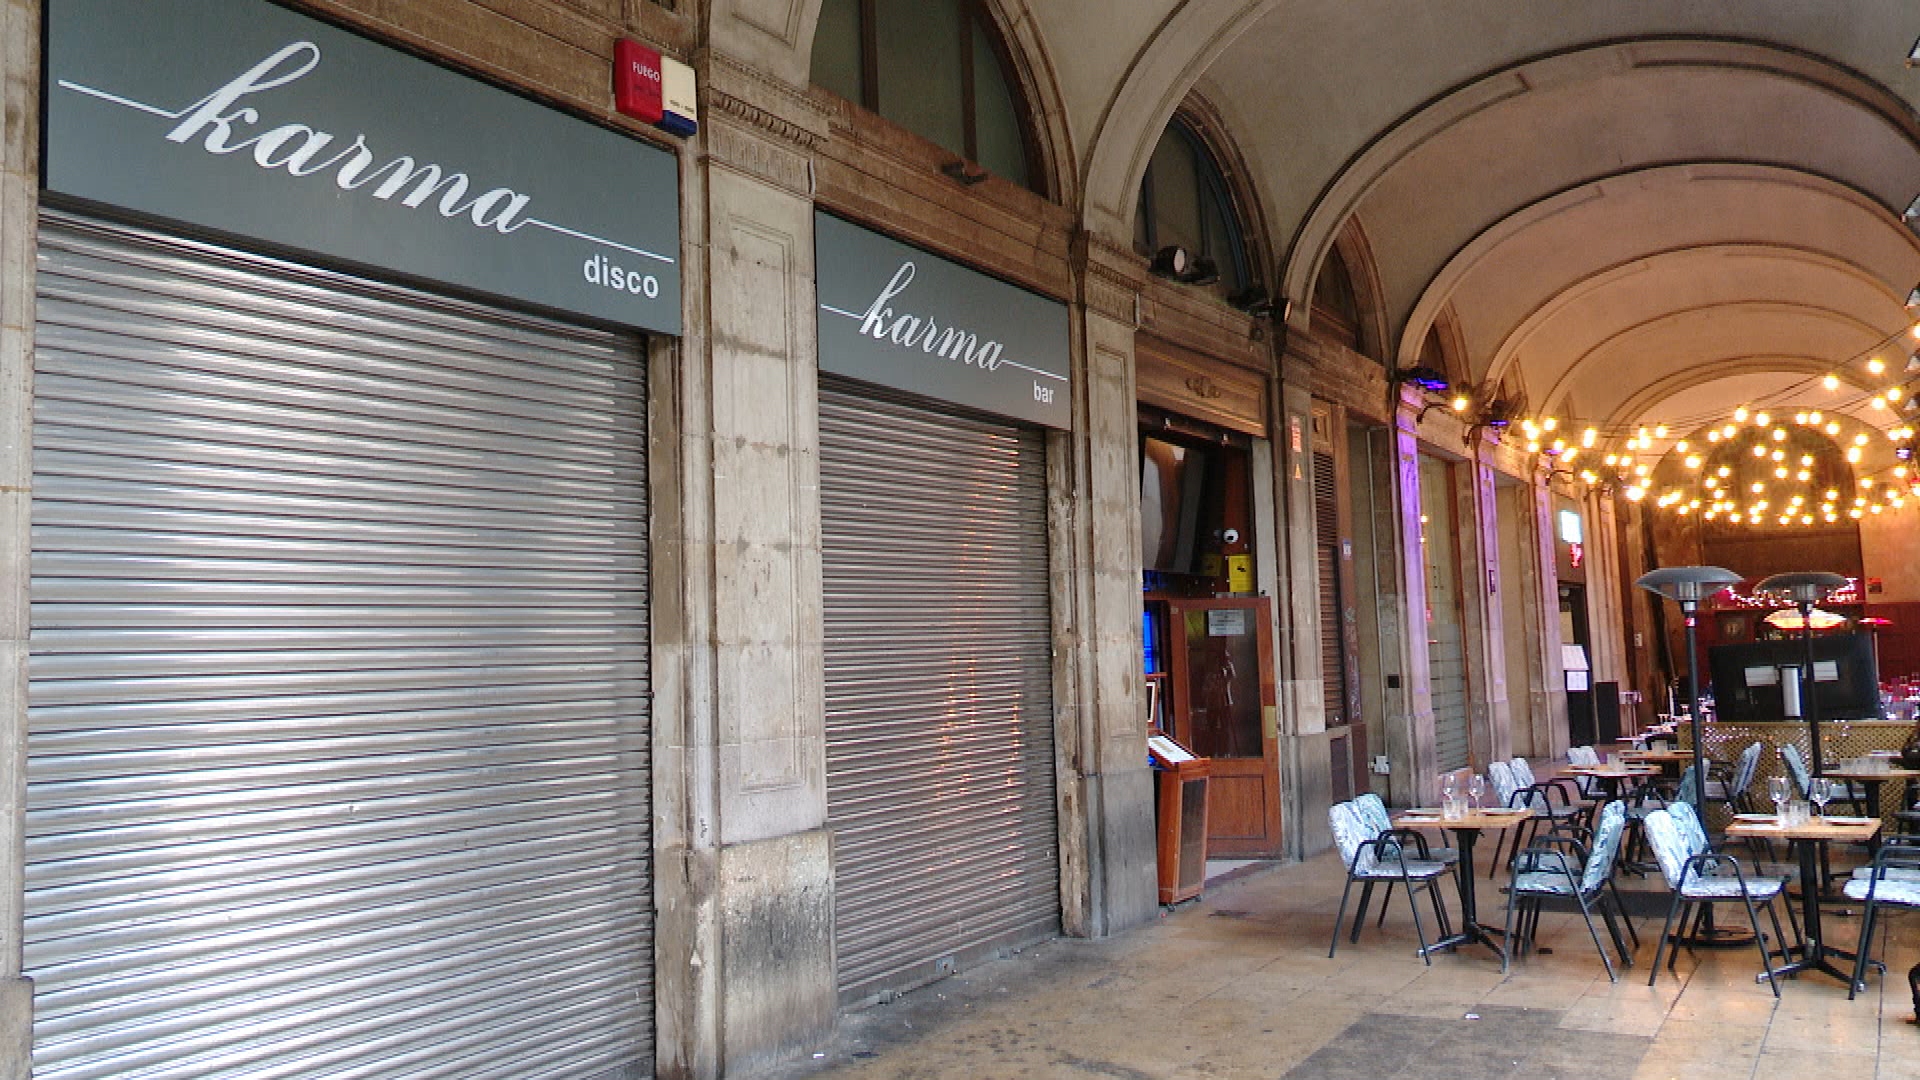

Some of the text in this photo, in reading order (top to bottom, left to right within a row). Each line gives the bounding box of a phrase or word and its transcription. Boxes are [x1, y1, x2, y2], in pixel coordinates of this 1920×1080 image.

[632, 61, 660, 82] FUEGO
[166, 40, 533, 234] karma
[583, 252, 660, 300] disco
[859, 261, 1004, 371] karma
[1033, 379, 1055, 405] bar
